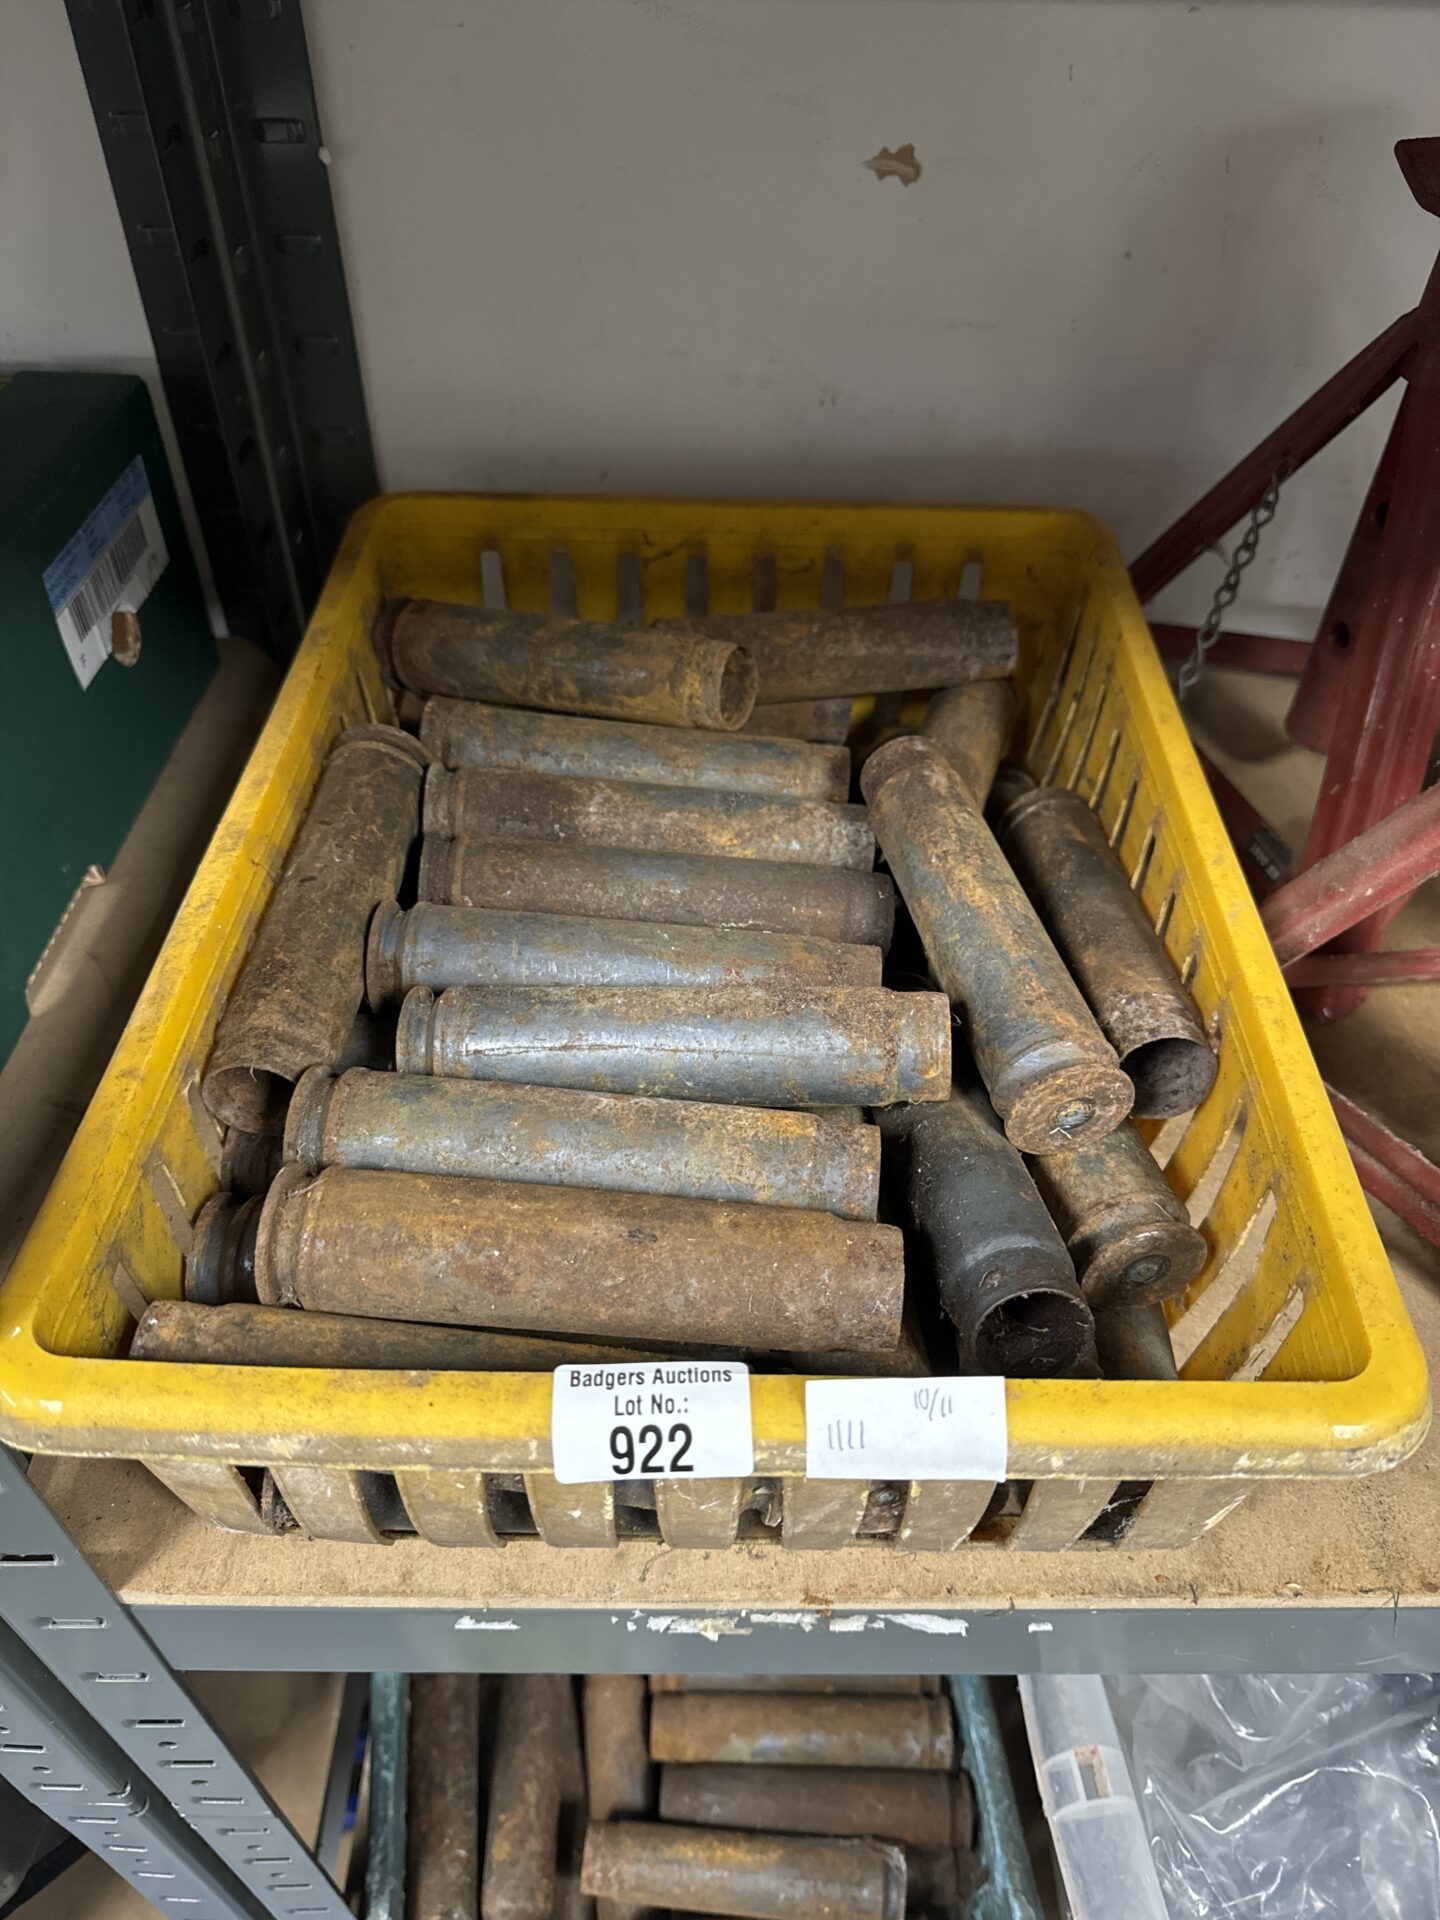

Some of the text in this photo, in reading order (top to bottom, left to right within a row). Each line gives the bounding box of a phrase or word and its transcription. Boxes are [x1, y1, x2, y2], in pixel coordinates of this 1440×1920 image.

[569, 1367, 733, 1390] Badgers Auctions
[614, 1393, 689, 1416] Lot No.:
[609, 1423, 695, 1475] 922
